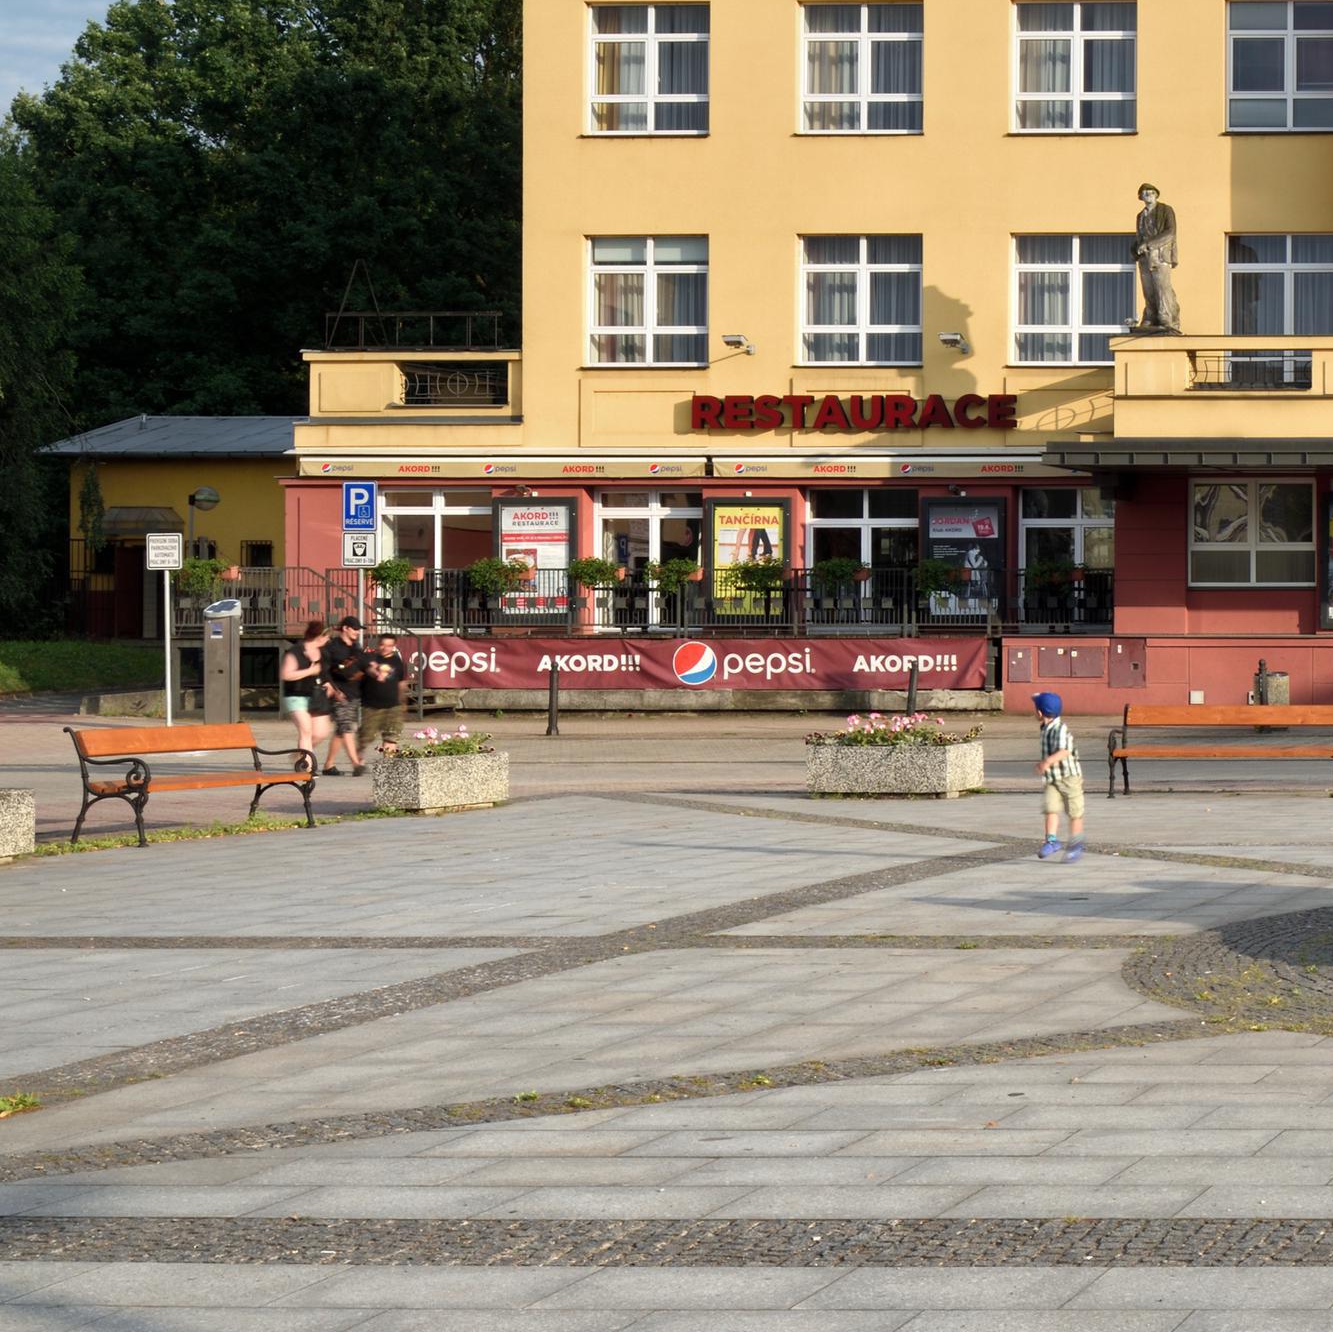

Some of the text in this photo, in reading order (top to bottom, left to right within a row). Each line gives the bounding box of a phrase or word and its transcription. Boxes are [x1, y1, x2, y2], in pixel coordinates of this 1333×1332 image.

[691, 394, 1018, 429] RESTAURACE
[350, 488, 369, 516] P
[718, 513, 779, 525] TANČÍRNA
[537, 654, 641, 673] AKORD!!!
[723, 647, 812, 680] pepsi
